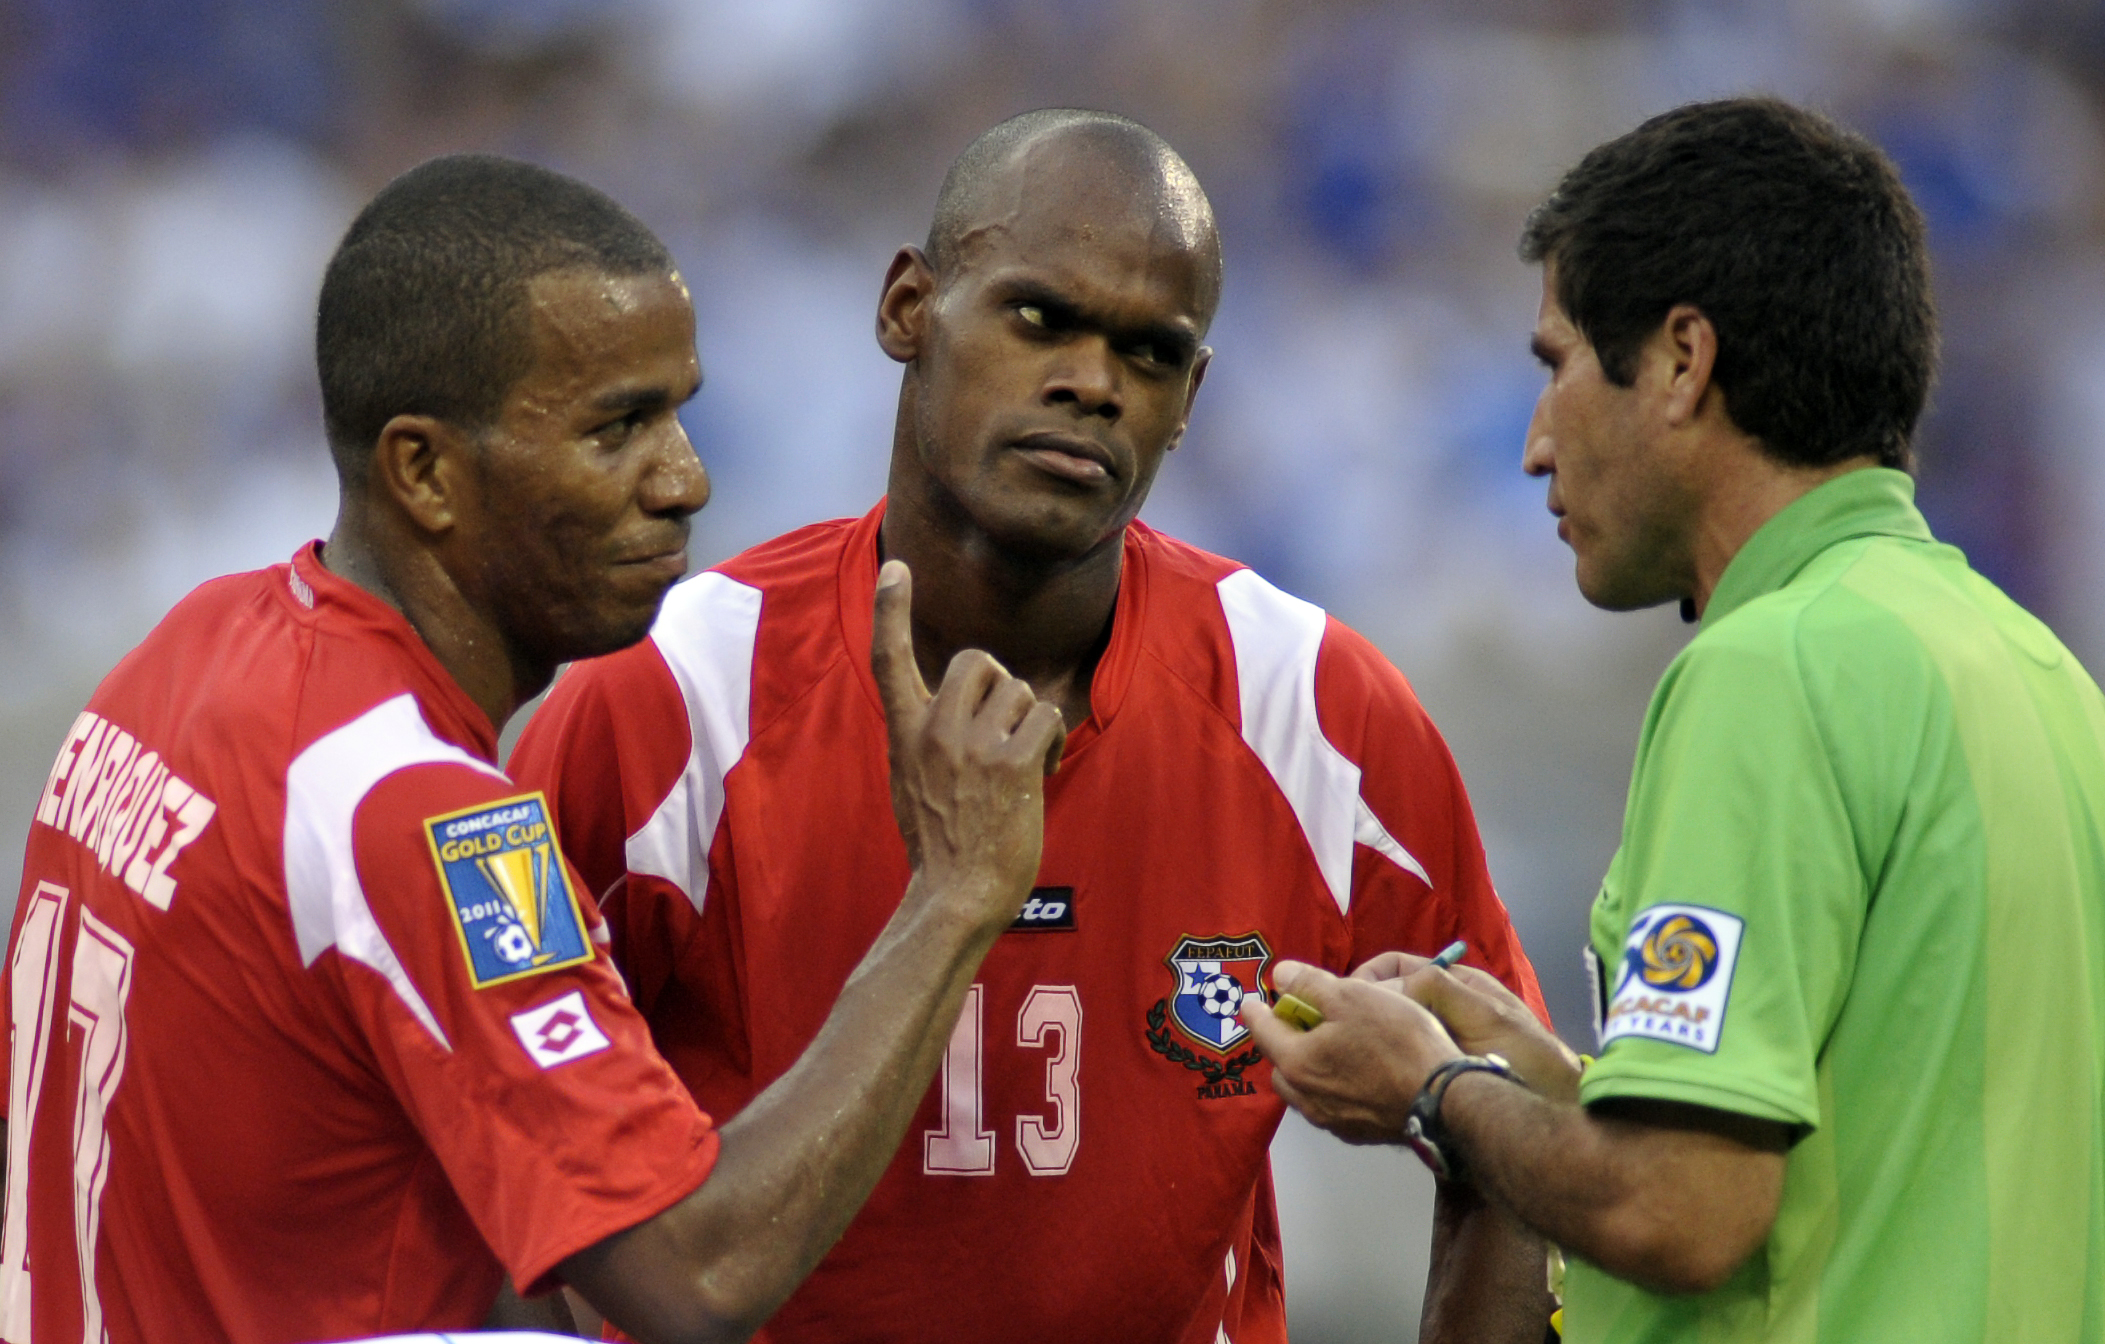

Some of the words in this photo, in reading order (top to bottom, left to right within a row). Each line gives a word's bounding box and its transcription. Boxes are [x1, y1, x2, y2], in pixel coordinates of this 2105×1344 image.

[36, 711, 217, 912] ENRIQUEZ
[446, 805, 532, 838] CONCACAF
[441, 831, 502, 863] GOLD
[506, 821, 547, 846] CUP
[459, 899, 500, 924] 2011
[1016, 898, 1067, 920] to
[1187, 944, 1255, 959] FEPAFUT
[1630, 1016, 1705, 1042] YEARS
[924, 983, 1083, 1176] 13
[0, 880, 135, 1344] 17
